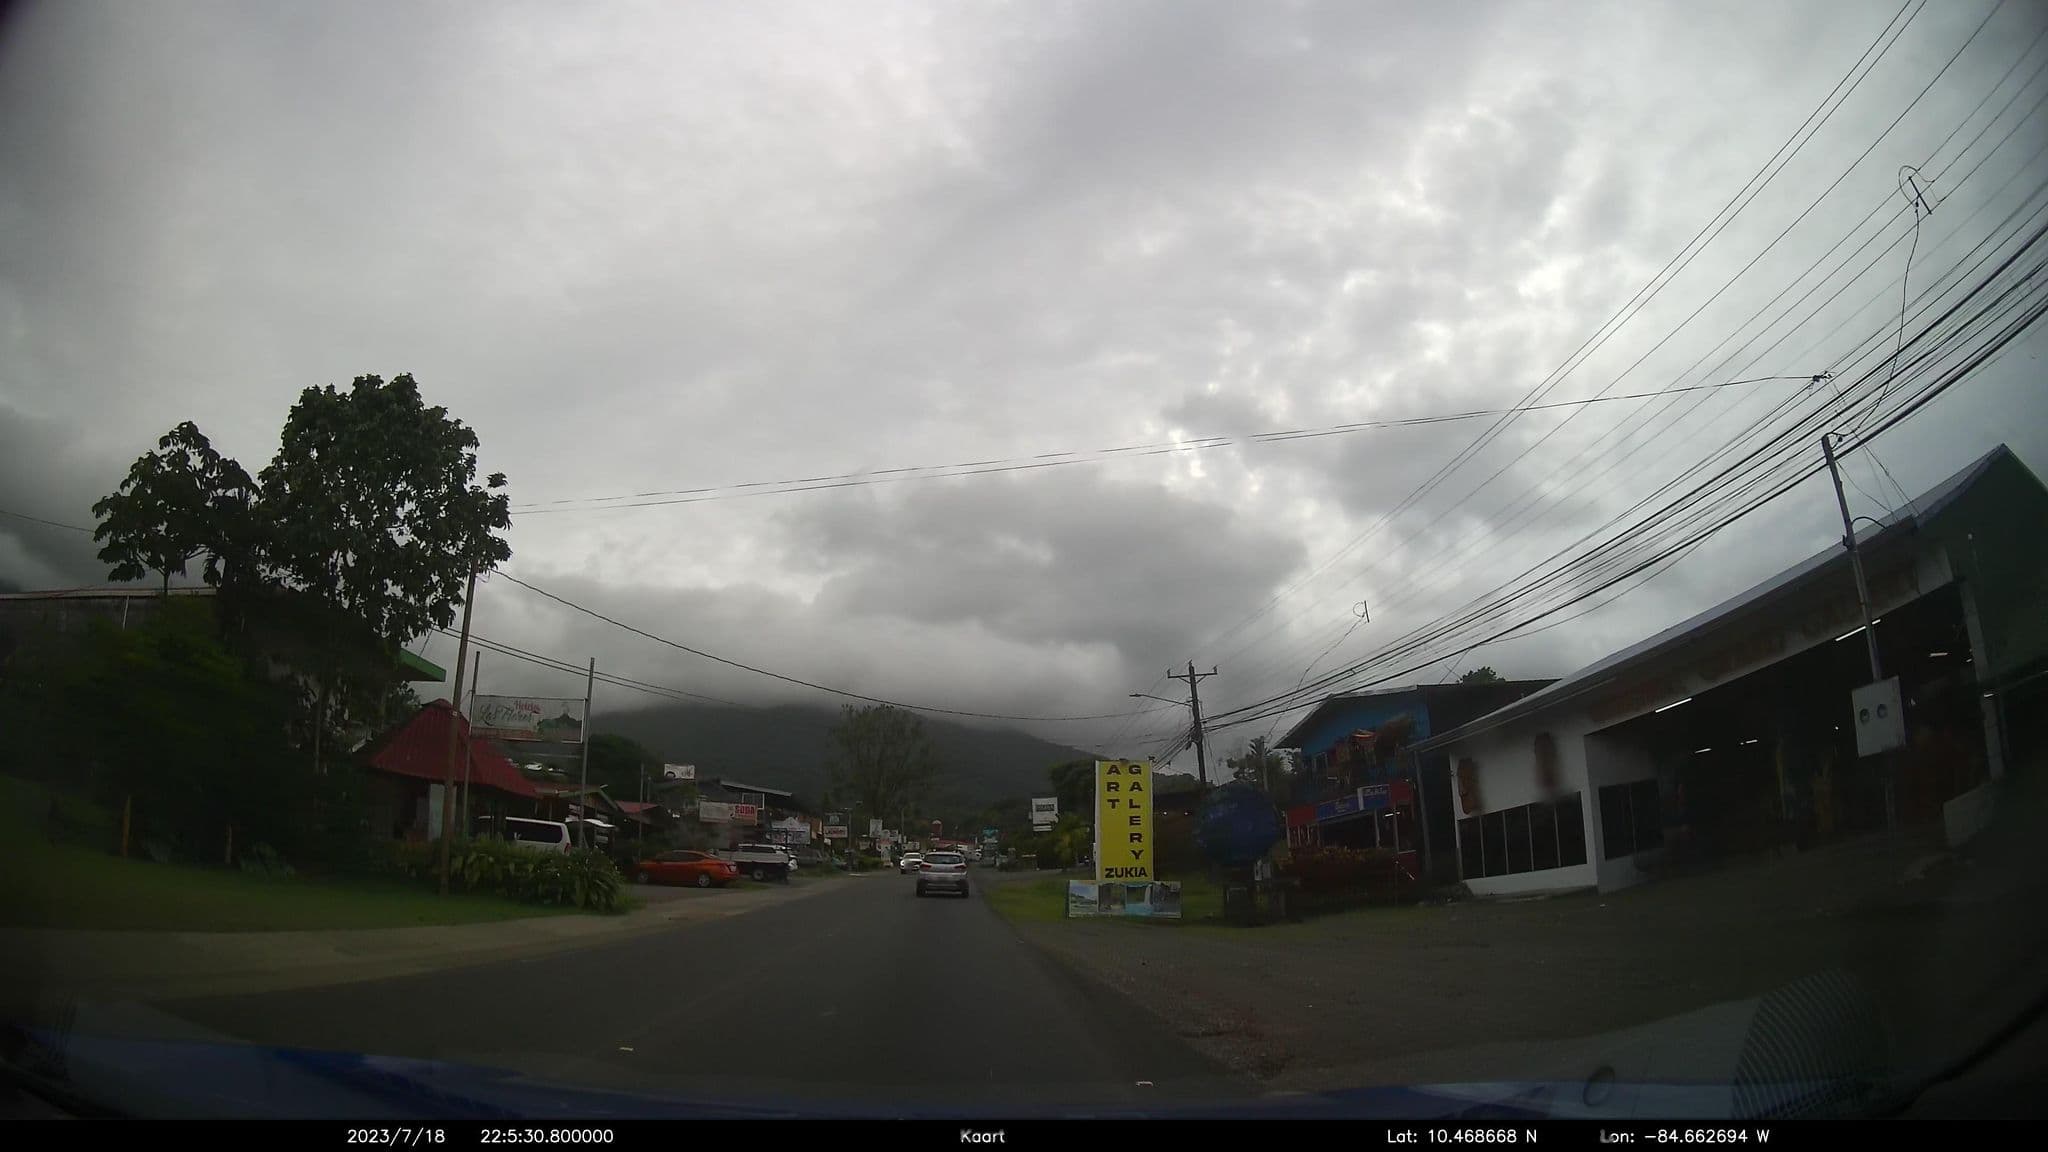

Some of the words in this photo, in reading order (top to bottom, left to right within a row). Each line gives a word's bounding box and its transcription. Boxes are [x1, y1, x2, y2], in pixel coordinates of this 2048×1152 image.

[1107, 764, 1120, 809] ART
[735, 805, 755, 815] SODA
[1129, 764, 1143, 860] GALERY
[1105, 867, 1147, 879] ZUKIA
